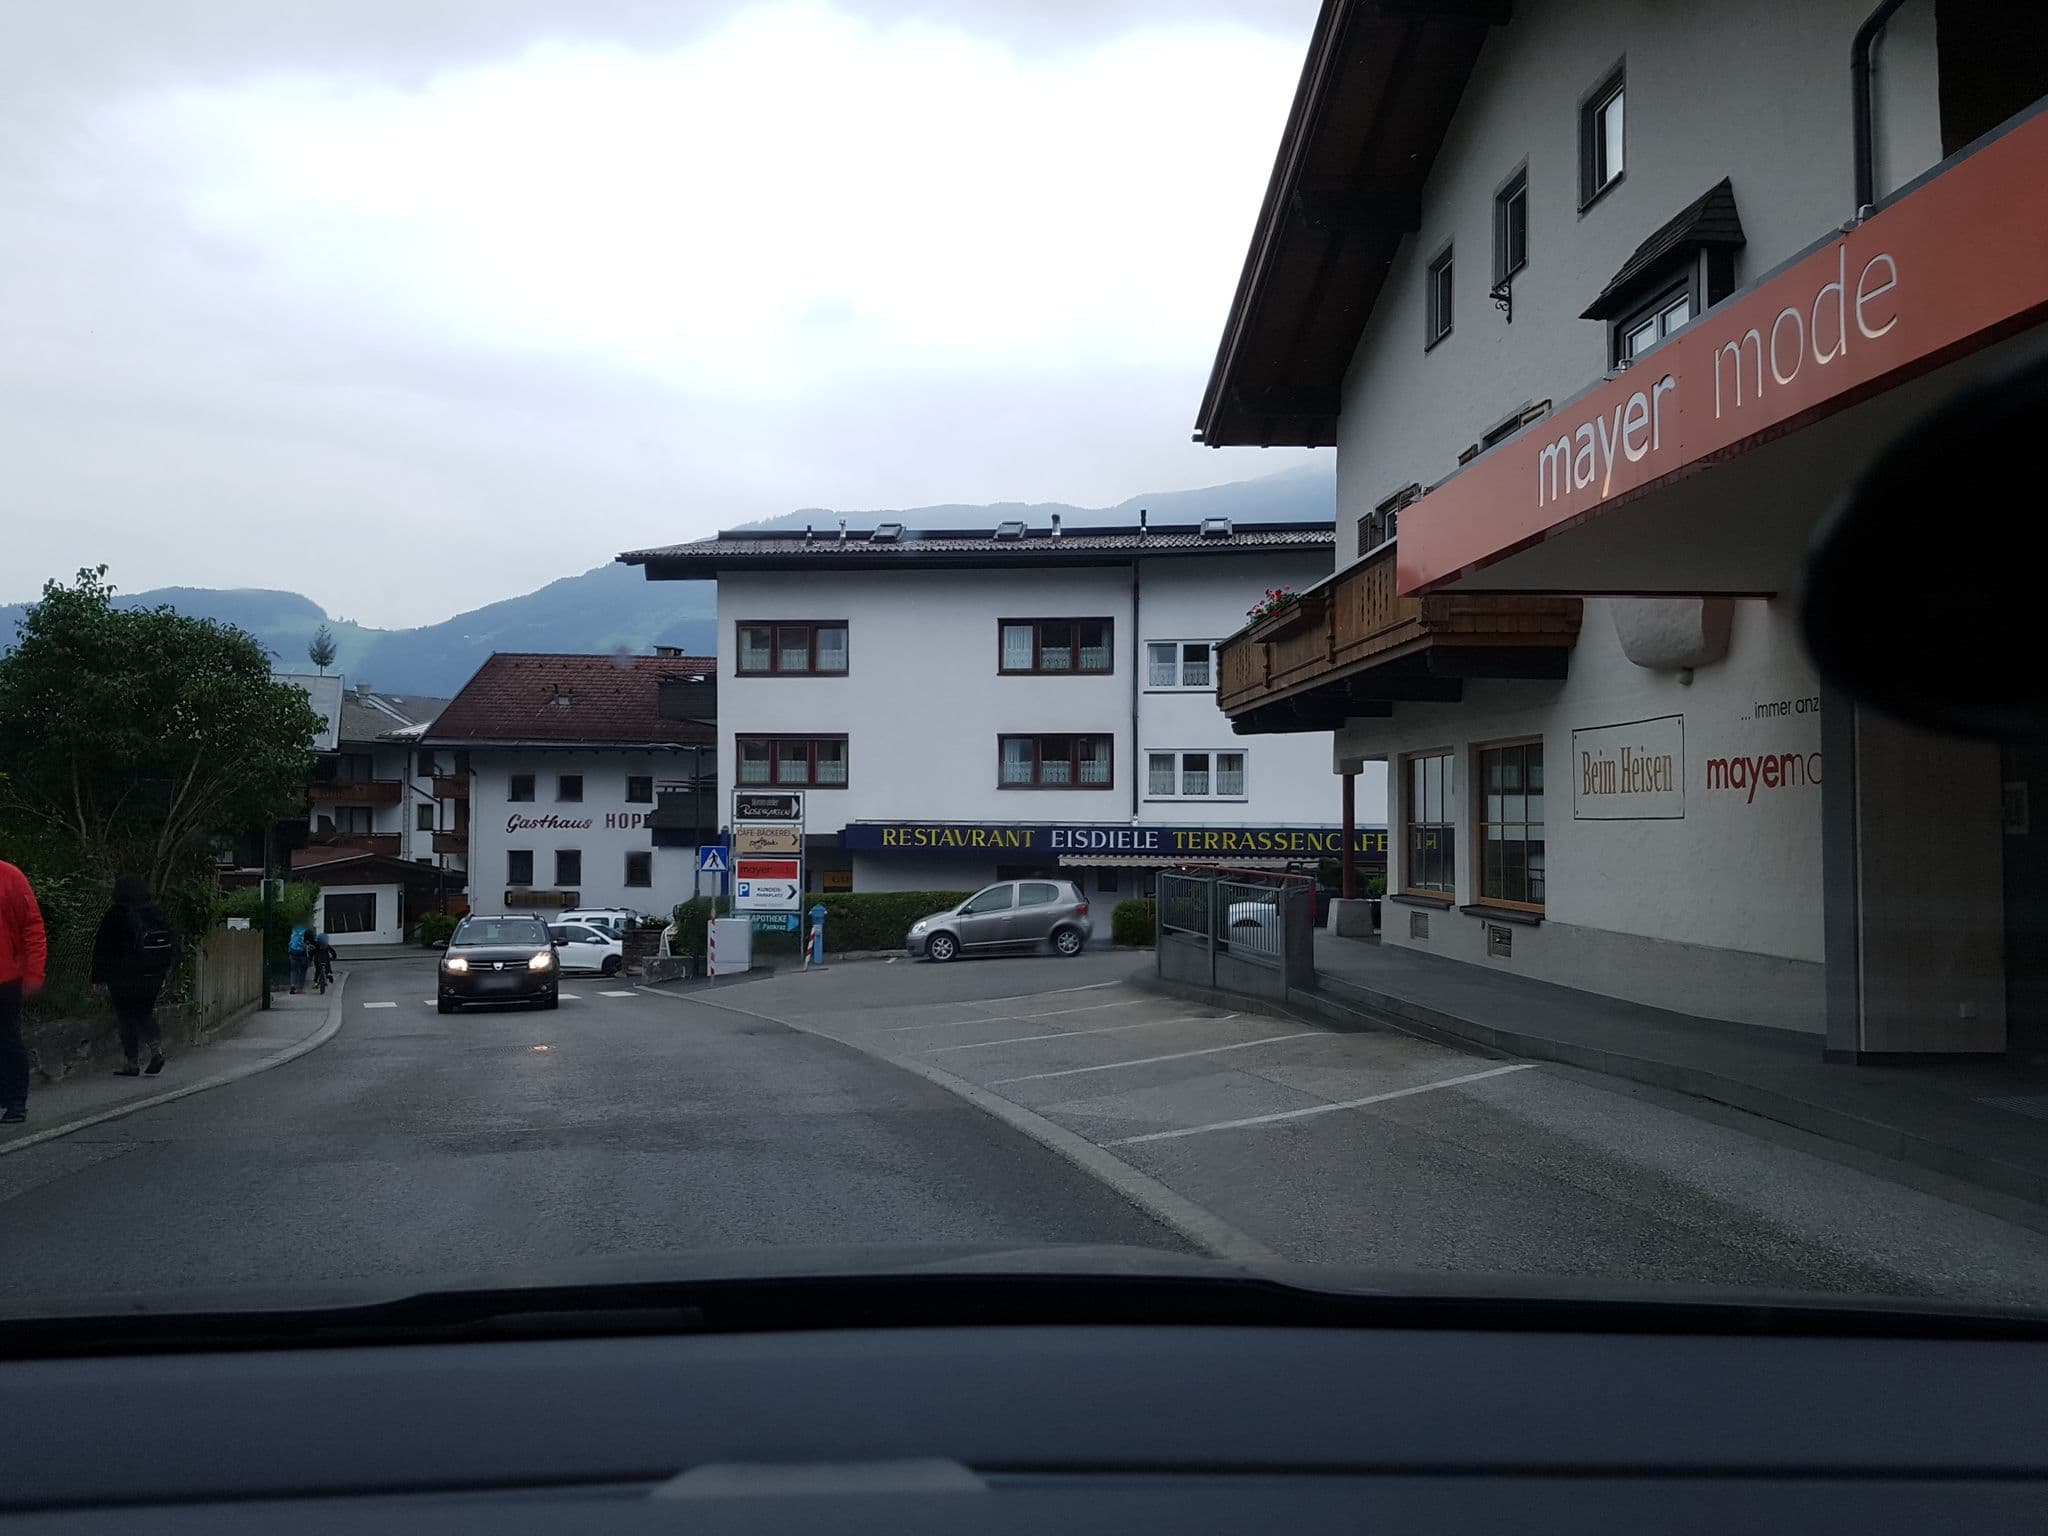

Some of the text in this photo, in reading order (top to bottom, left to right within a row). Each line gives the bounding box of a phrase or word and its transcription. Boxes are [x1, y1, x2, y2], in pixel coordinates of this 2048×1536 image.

[1537, 243, 1898, 508] mayer mode
[1754, 700, 1792, 719] immer
[1581, 745, 1673, 796] Beim Heisen
[505, 813, 593, 833] Gasthaus
[1050, 830, 1159, 849] EISDIELE
